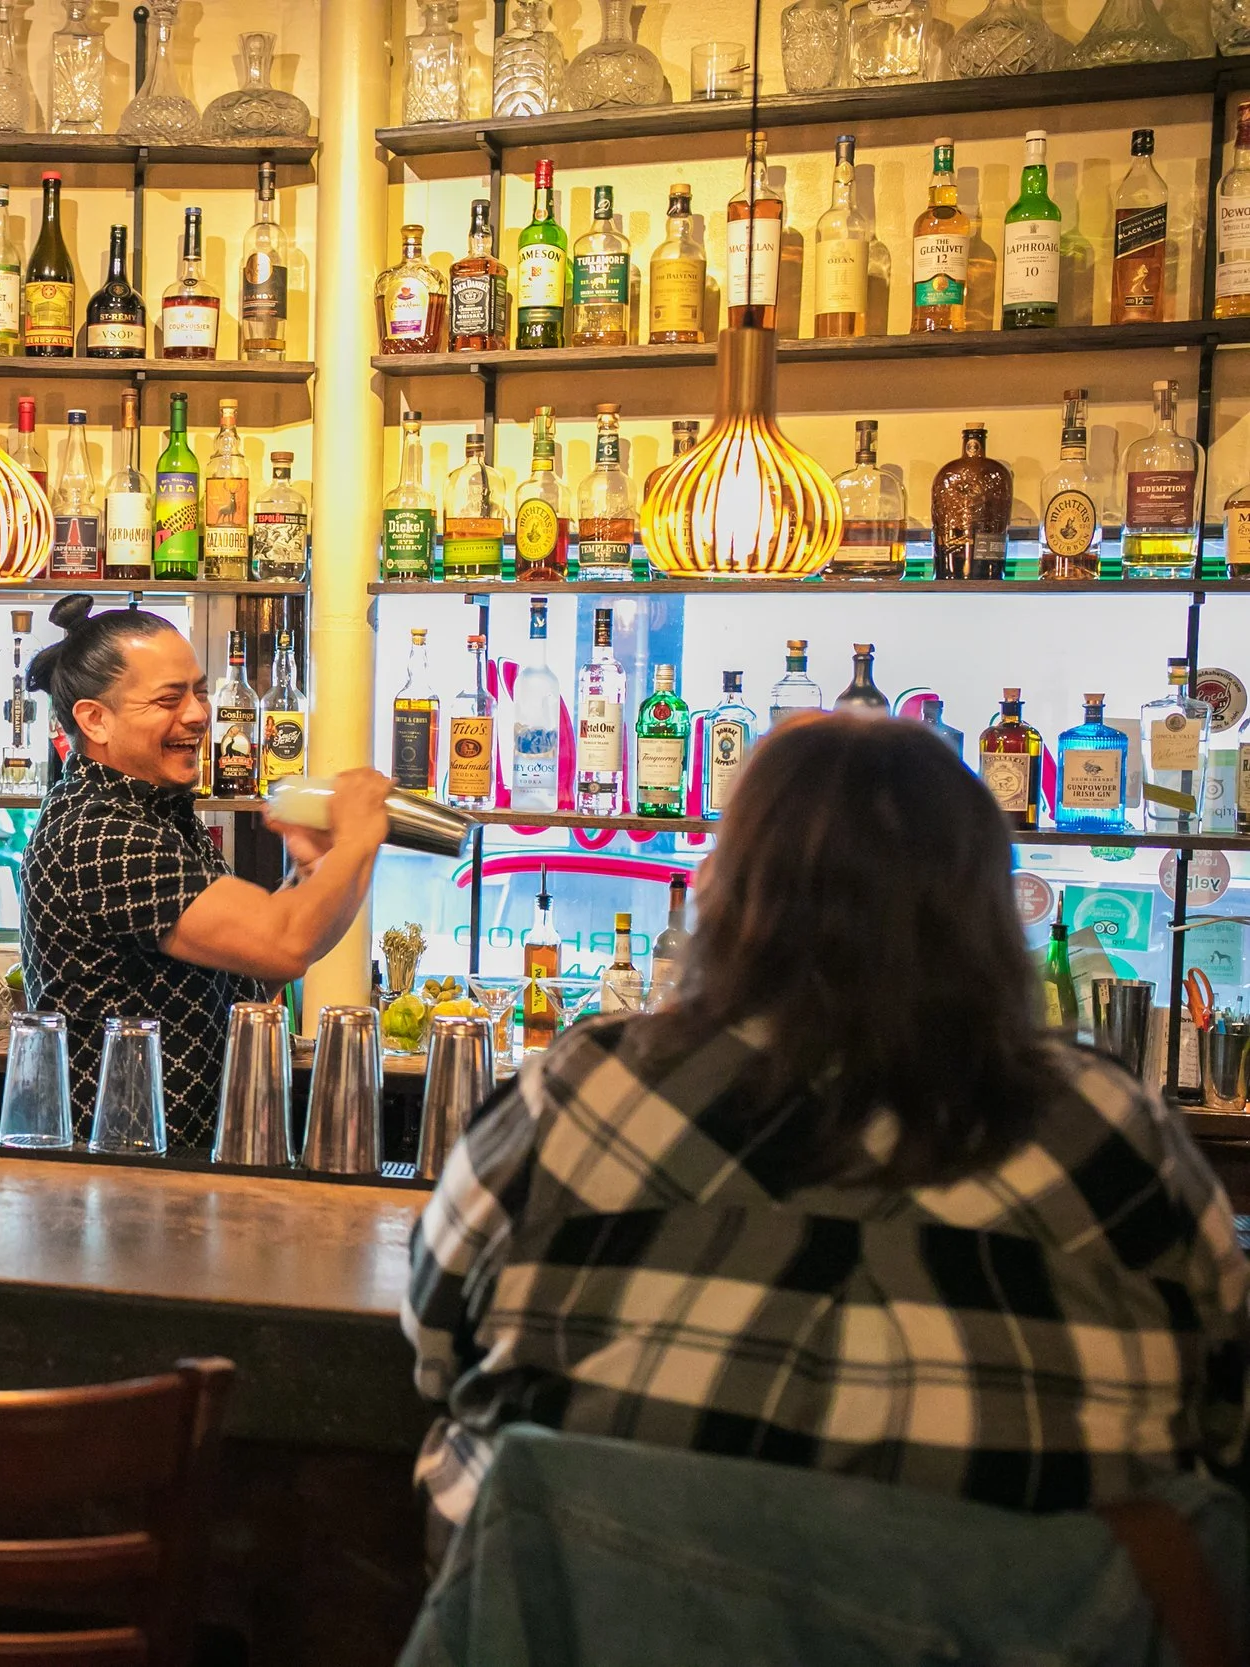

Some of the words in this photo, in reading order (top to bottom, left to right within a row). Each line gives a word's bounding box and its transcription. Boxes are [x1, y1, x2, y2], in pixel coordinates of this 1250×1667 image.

[1118, 227, 1142, 240] BLACK
[1144, 218, 1165, 230] LABEL
[920, 245, 964, 255] GLENLIVET
[1007, 243, 1059, 255] LAPHROAIG
[518, 249, 561, 265] JAMESON
[577, 256, 625, 266] TULLAMORE
[936, 254, 947, 264] 12
[1025, 267, 1039, 277] 10
[453, 281, 467, 294] JACK
[1135, 297, 1144, 305] 12
[102, 330, 134, 339] VSOP
[604, 444, 612, 455] 6
[159, 484, 195, 493] VIDA
[1136, 485, 1186, 493] REDEMPTION
[395, 512, 418, 520] GEORGE
[1050, 500, 1090, 522] MICHTER'S
[258, 513, 285, 523] ESPOLÓN
[520, 506, 553, 528] MICHTER'S
[388, 520, 425, 533] Dickel
[206, 532, 246, 548] CAZADORES
[1049, 534, 1090, 552] BOURBON
[581, 544, 627, 554] TEMPLETON
[220, 710, 254, 721] Goslings
[453, 722, 487, 735] Tito's
[580, 723, 599, 734] Ketel
[600, 723, 615, 733] One
[716, 727, 738, 737] BOMBAY
[642, 753, 678, 762] Tanqueray
[714, 756, 738, 766] SAPPHIRE
[450, 760, 490, 771] Handmade
[527, 763, 555, 772] GOOSE
